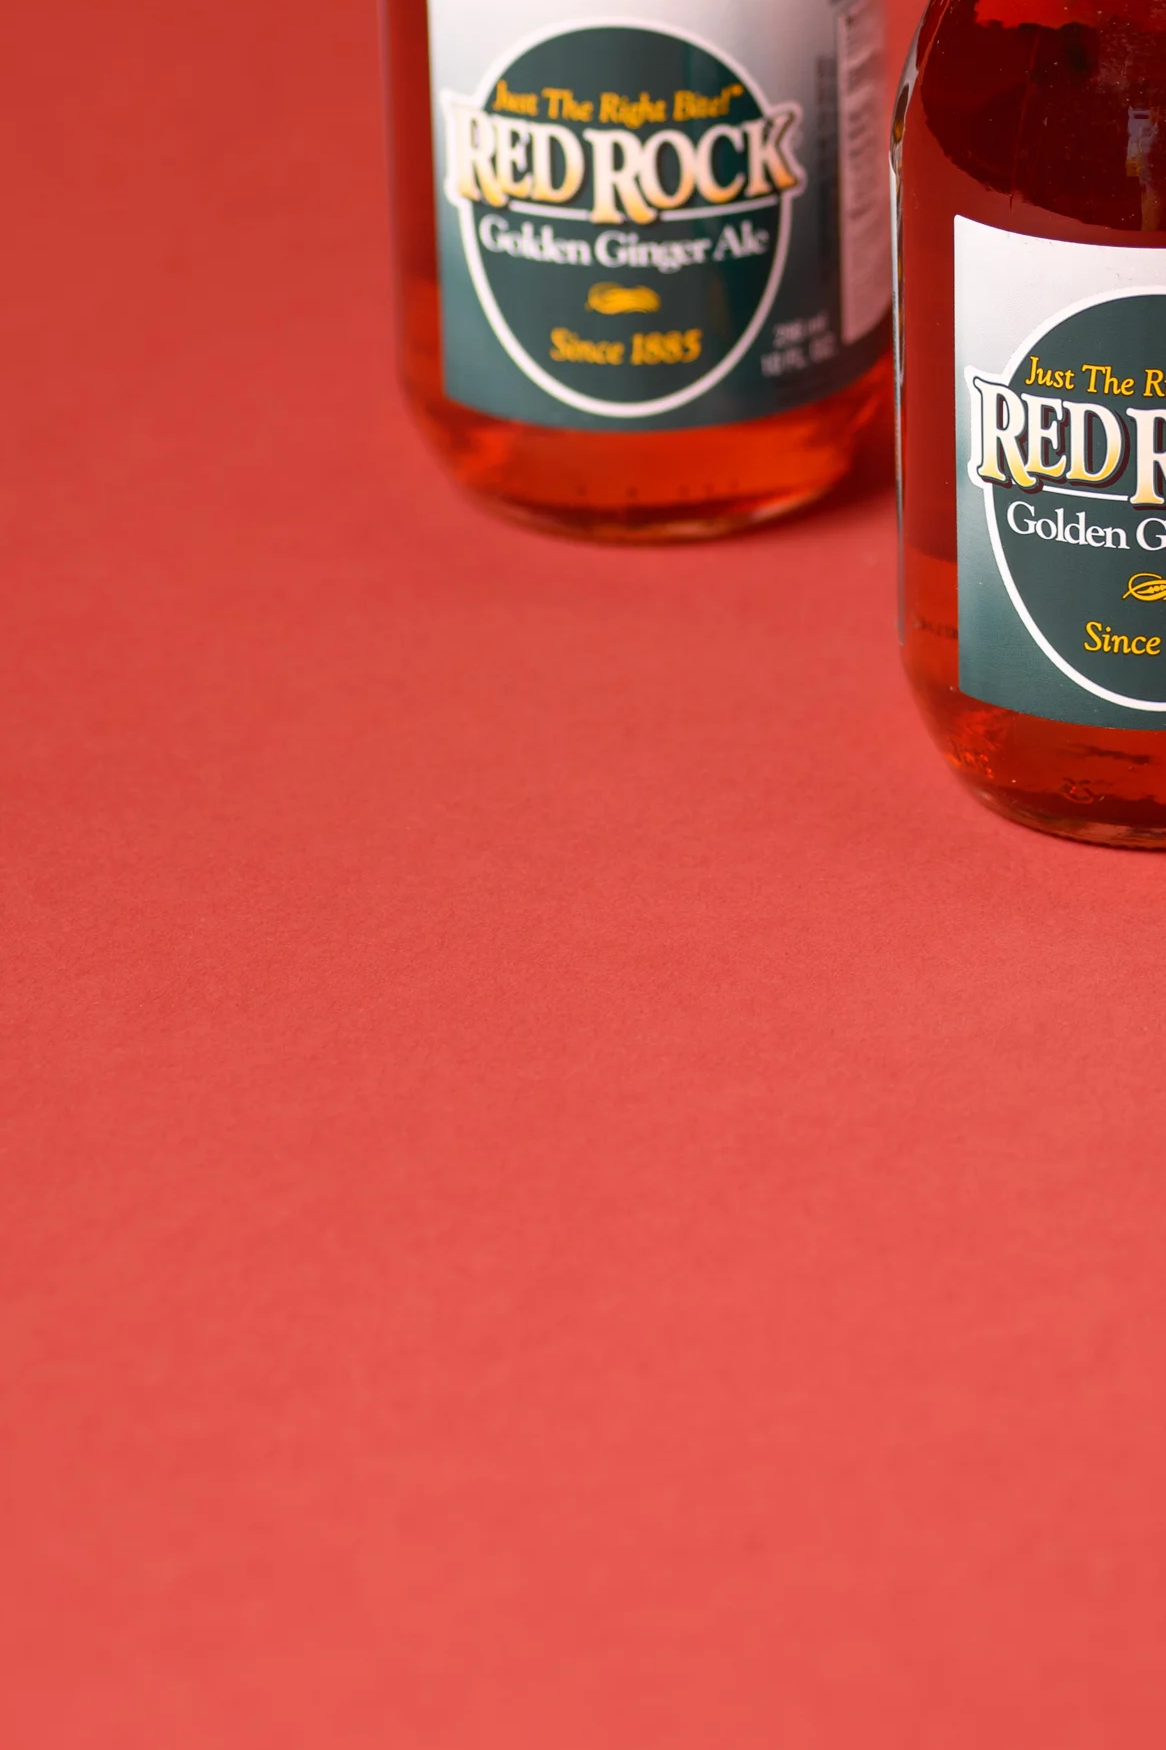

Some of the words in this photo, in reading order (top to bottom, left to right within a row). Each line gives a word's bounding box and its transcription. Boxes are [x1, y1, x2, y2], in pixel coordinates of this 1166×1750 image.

[492, 79, 539, 116] Just
[542, 87, 594, 122] The
[599, 91, 667, 129] Right
[452, 104, 586, 208] RED
[583, 111, 799, 225] ROCK
[479, 214, 592, 266] Golden
[594, 230, 711, 274] Ginger
[713, 219, 770, 260] Ale
[550, 327, 625, 365] Since
[631, 328, 702, 365] 1885
[1025, 356, 1075, 390] Just
[1082, 364, 1134, 395] The
[973, 376, 1127, 493] RED
[1006, 500, 1130, 549] Golden
[1083, 620, 1161, 655] Since
